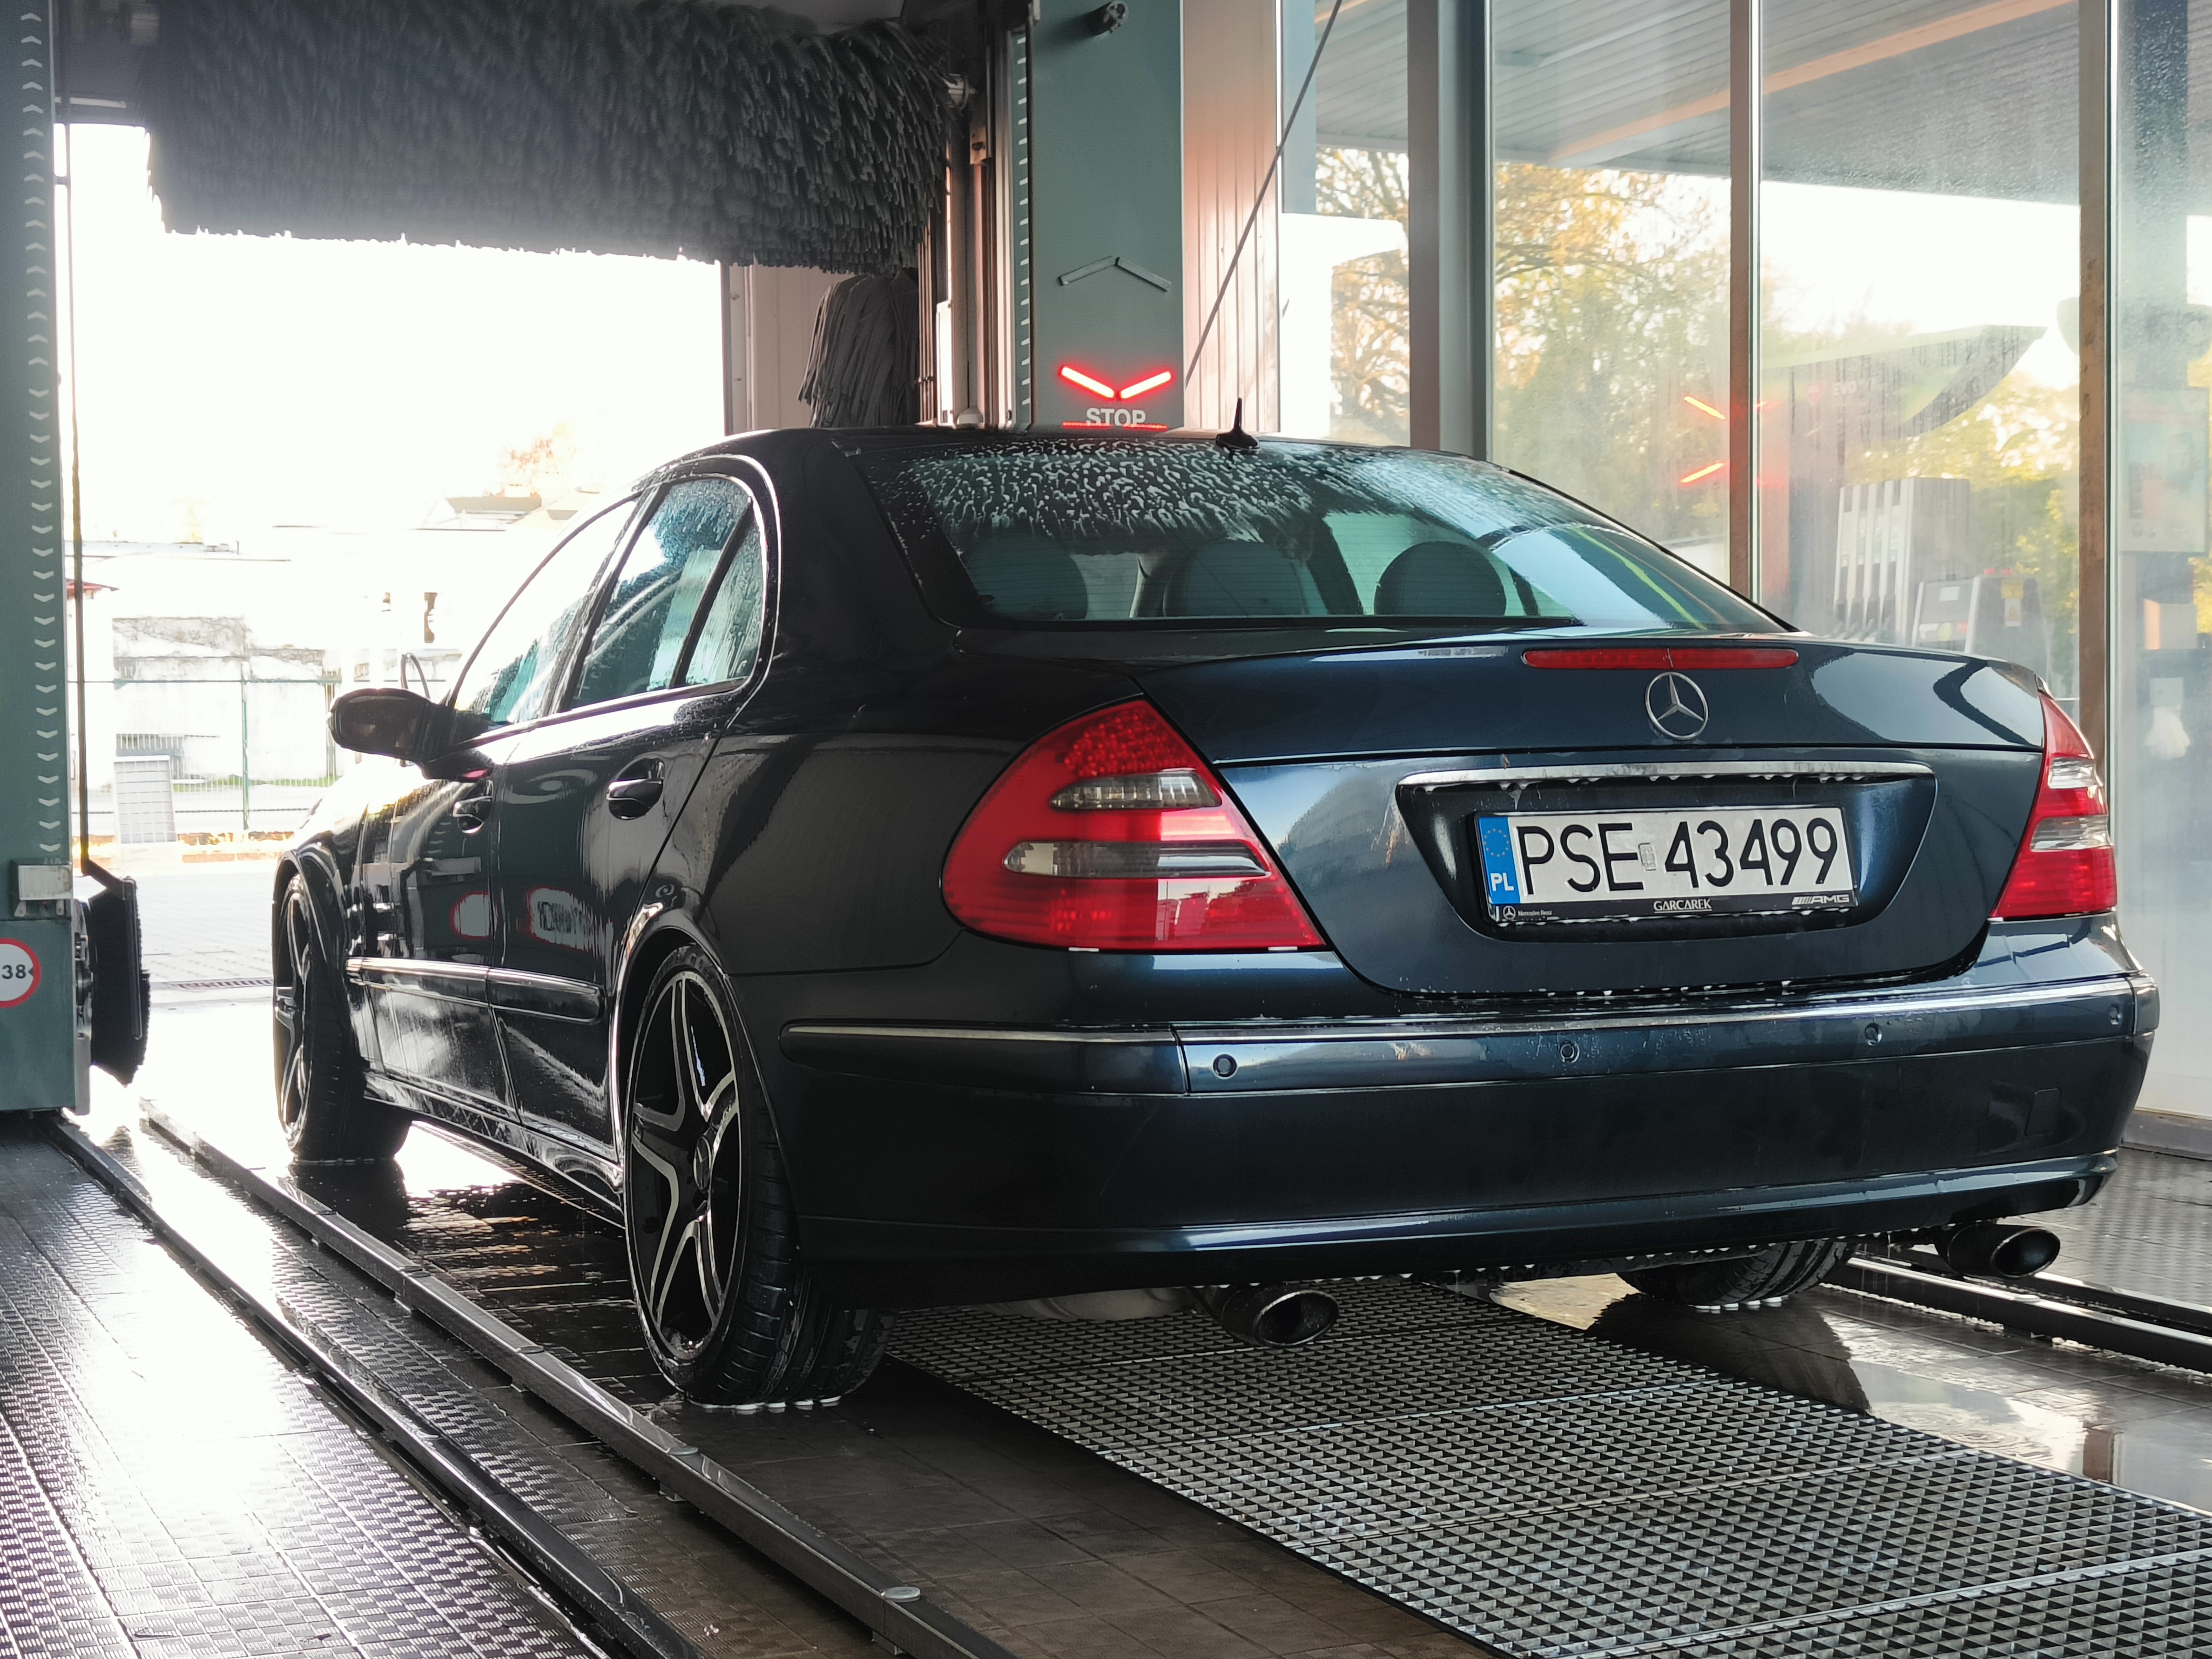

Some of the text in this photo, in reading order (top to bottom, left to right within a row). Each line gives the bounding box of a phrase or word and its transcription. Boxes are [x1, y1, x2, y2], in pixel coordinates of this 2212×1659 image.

[1086, 407, 1146, 427] STOP
[1516, 817, 1838, 895] PSE 43499
[1491, 872, 1514, 892] PL
[1653, 899, 1712, 911] GARCAREK
